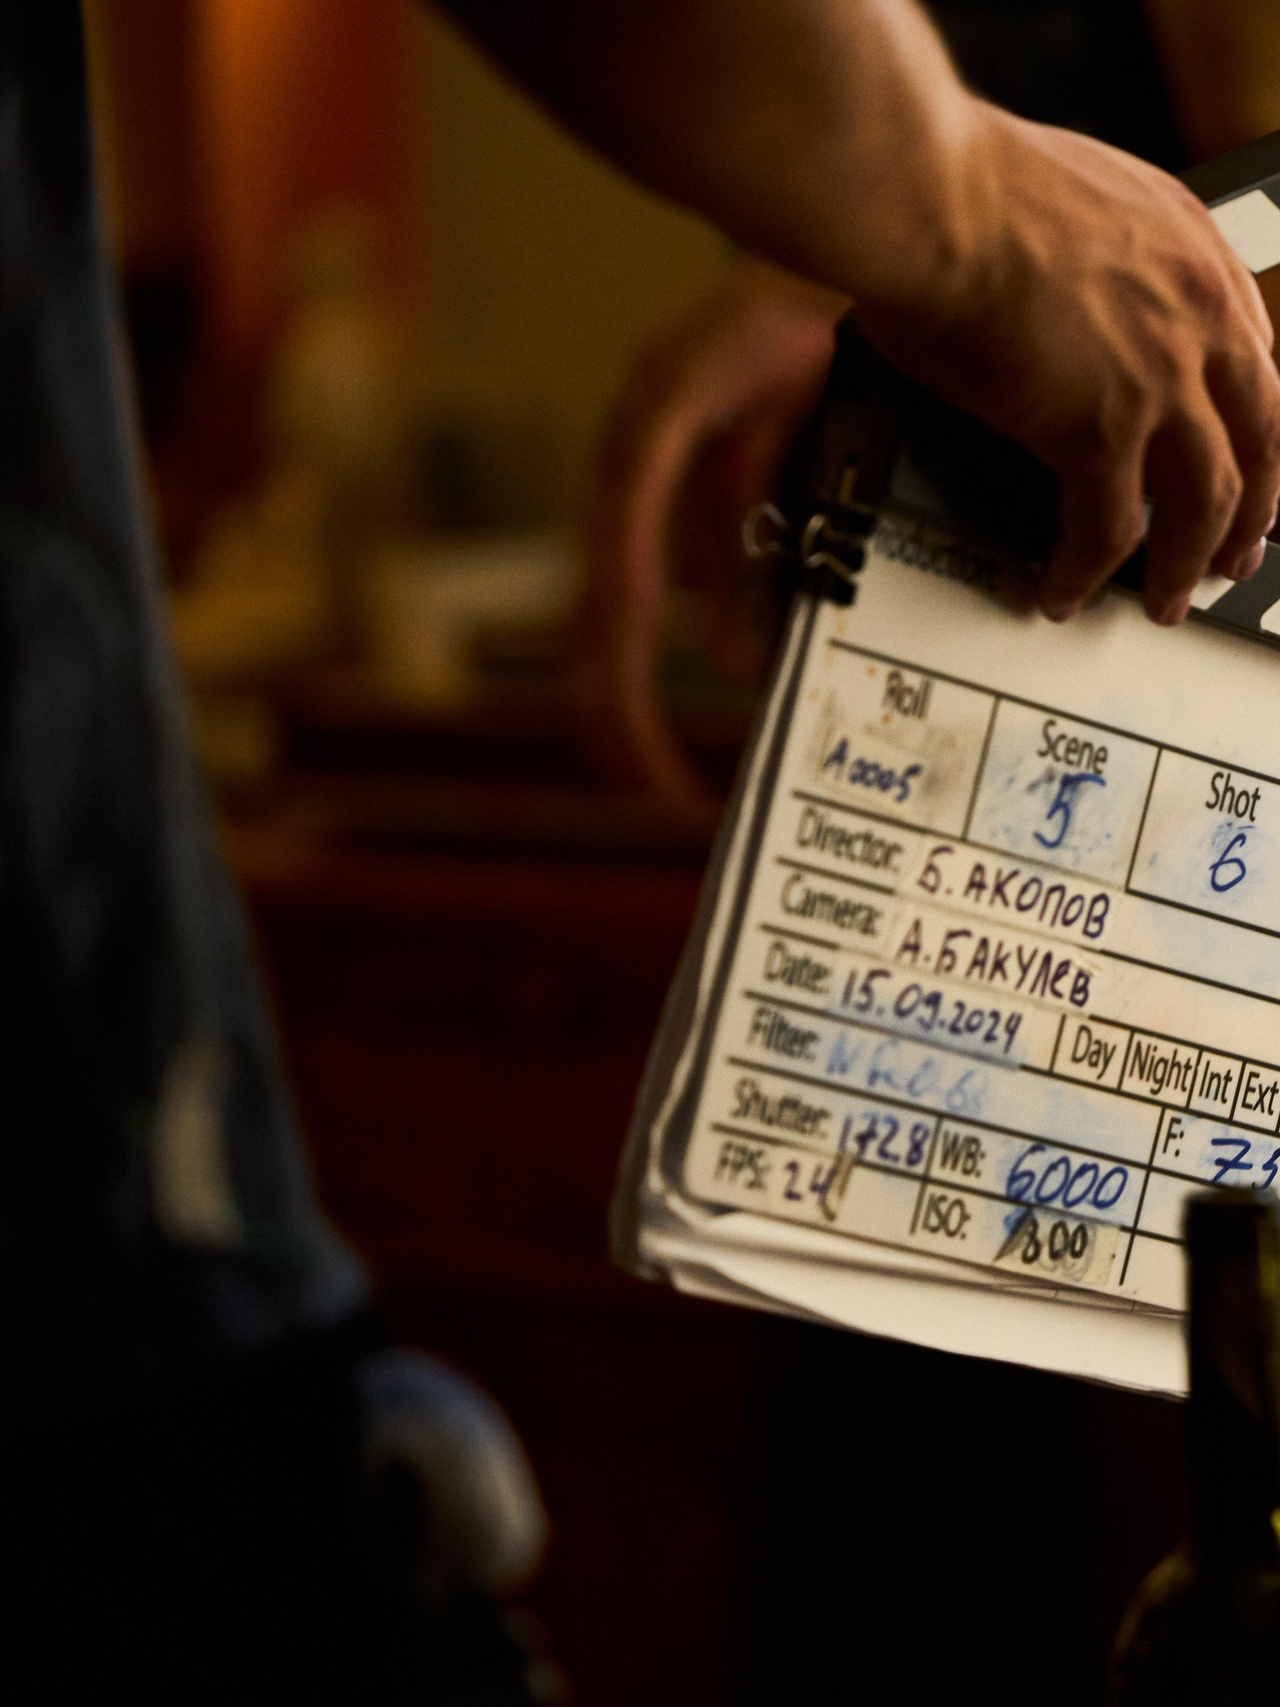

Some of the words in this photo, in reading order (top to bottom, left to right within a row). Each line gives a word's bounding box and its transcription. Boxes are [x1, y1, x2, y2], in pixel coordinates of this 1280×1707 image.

[881, 669, 934, 722] Roll
[1036, 719, 1109, 775] Scene
[1033, 773, 1107, 850] 5
[1205, 771, 1262, 823] Shot
[797, 805, 904, 873] Director:
[1209, 833, 1247, 893] 6
[780, 871, 883, 936] Camera:
[764, 940, 833, 995] Date:
[746, 1006, 821, 1063] Filter:
[841, 969, 1024, 1054] 15.09.2024
[1070, 1024, 1118, 1079] Day
[1128, 1040, 1192, 1099] Night
[730, 1076, 832, 1140] Shutter:
[1199, 1060, 1233, 1104] Int
[1241, 1071, 1279, 1116] Ext
[940, 1131, 986, 1178] WB:
[1163, 1116, 1185, 1158] F:
[713, 1140, 771, 1190] FPS:
[784, 1160, 838, 1206] 24
[1006, 1143, 1129, 1209] 6000
[922, 1191, 971, 1240] ISO:
[1021, 1215, 1089, 1265] 800
